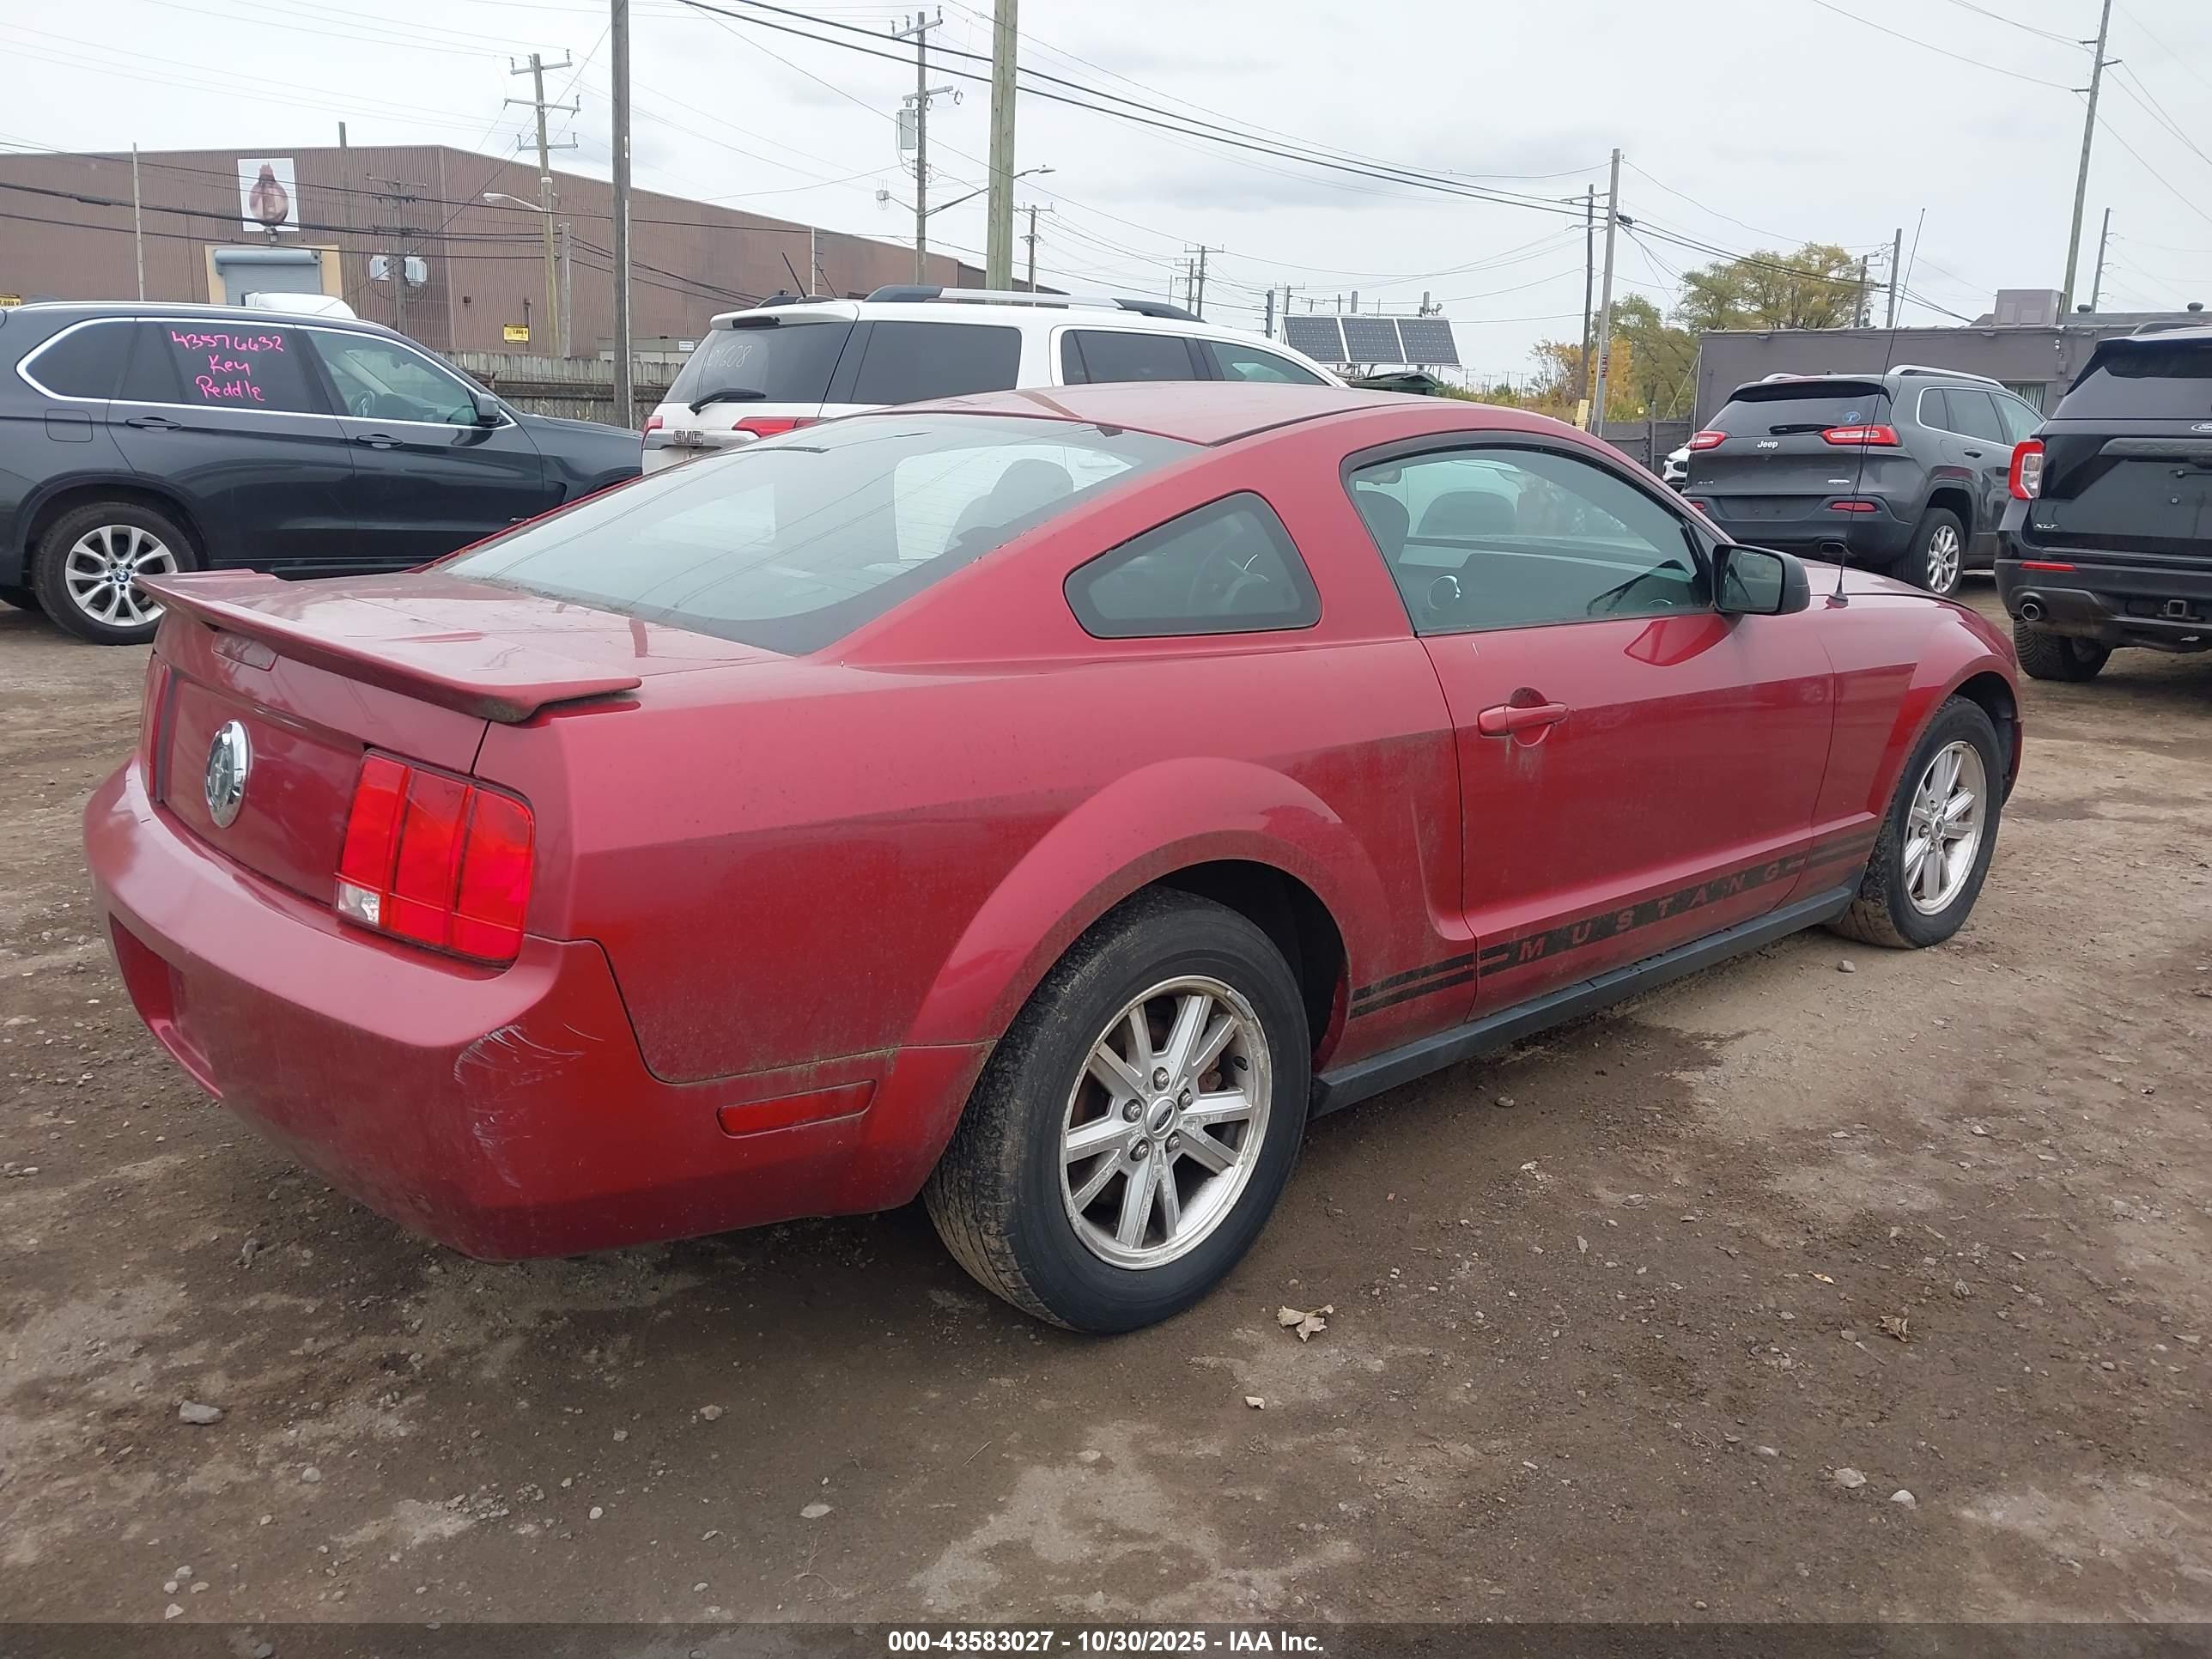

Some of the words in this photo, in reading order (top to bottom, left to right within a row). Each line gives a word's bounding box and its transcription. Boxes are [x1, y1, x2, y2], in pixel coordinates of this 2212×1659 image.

[171, 331, 284, 352] 43576632
[208, 354, 251, 376] Key
[673, 430, 703, 445] GMC
[1757, 441, 1778, 449] Jeep
[1518, 861, 1781, 962] MUSTANG
